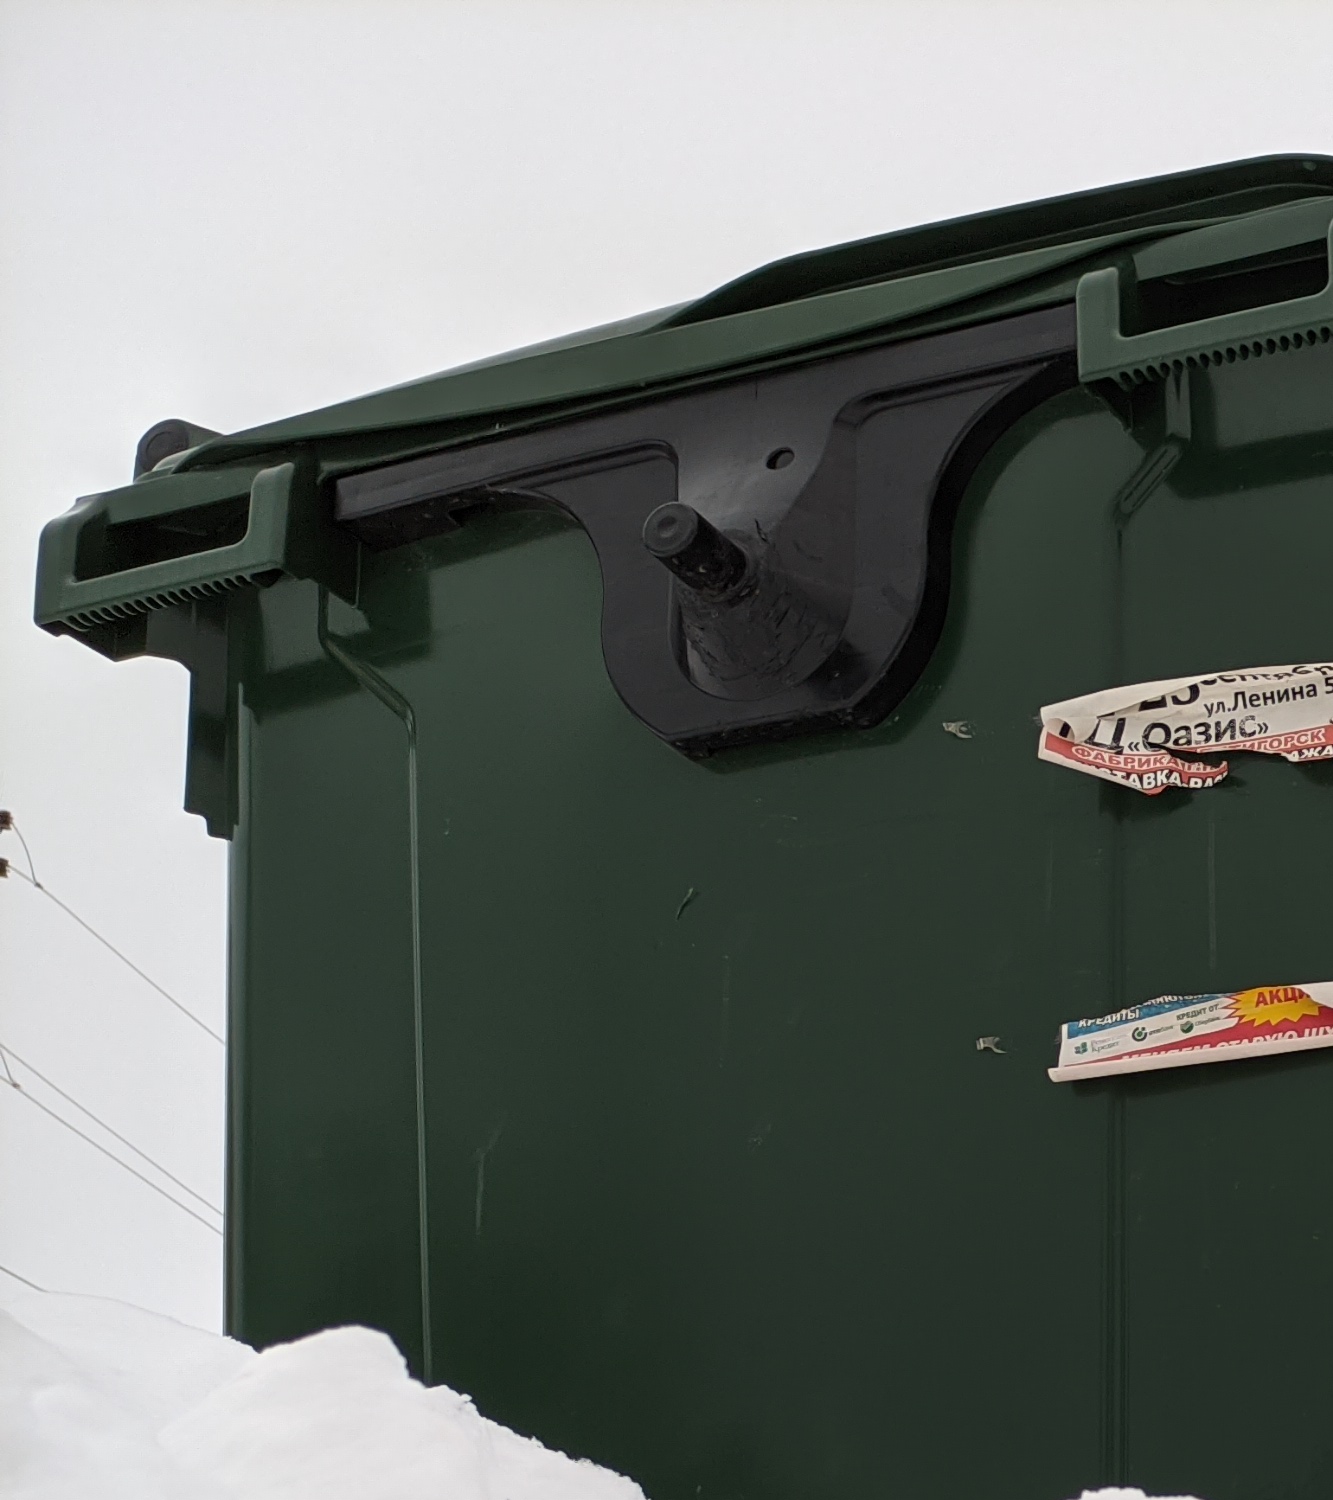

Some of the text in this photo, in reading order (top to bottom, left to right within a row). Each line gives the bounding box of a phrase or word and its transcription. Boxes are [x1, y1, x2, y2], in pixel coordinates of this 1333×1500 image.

[1203, 682, 1318, 718] ул.Ленина
[1073, 747, 1183, 772] ФАБРИКА
[1176, 1007, 1207, 1022] КРЕДИТ
